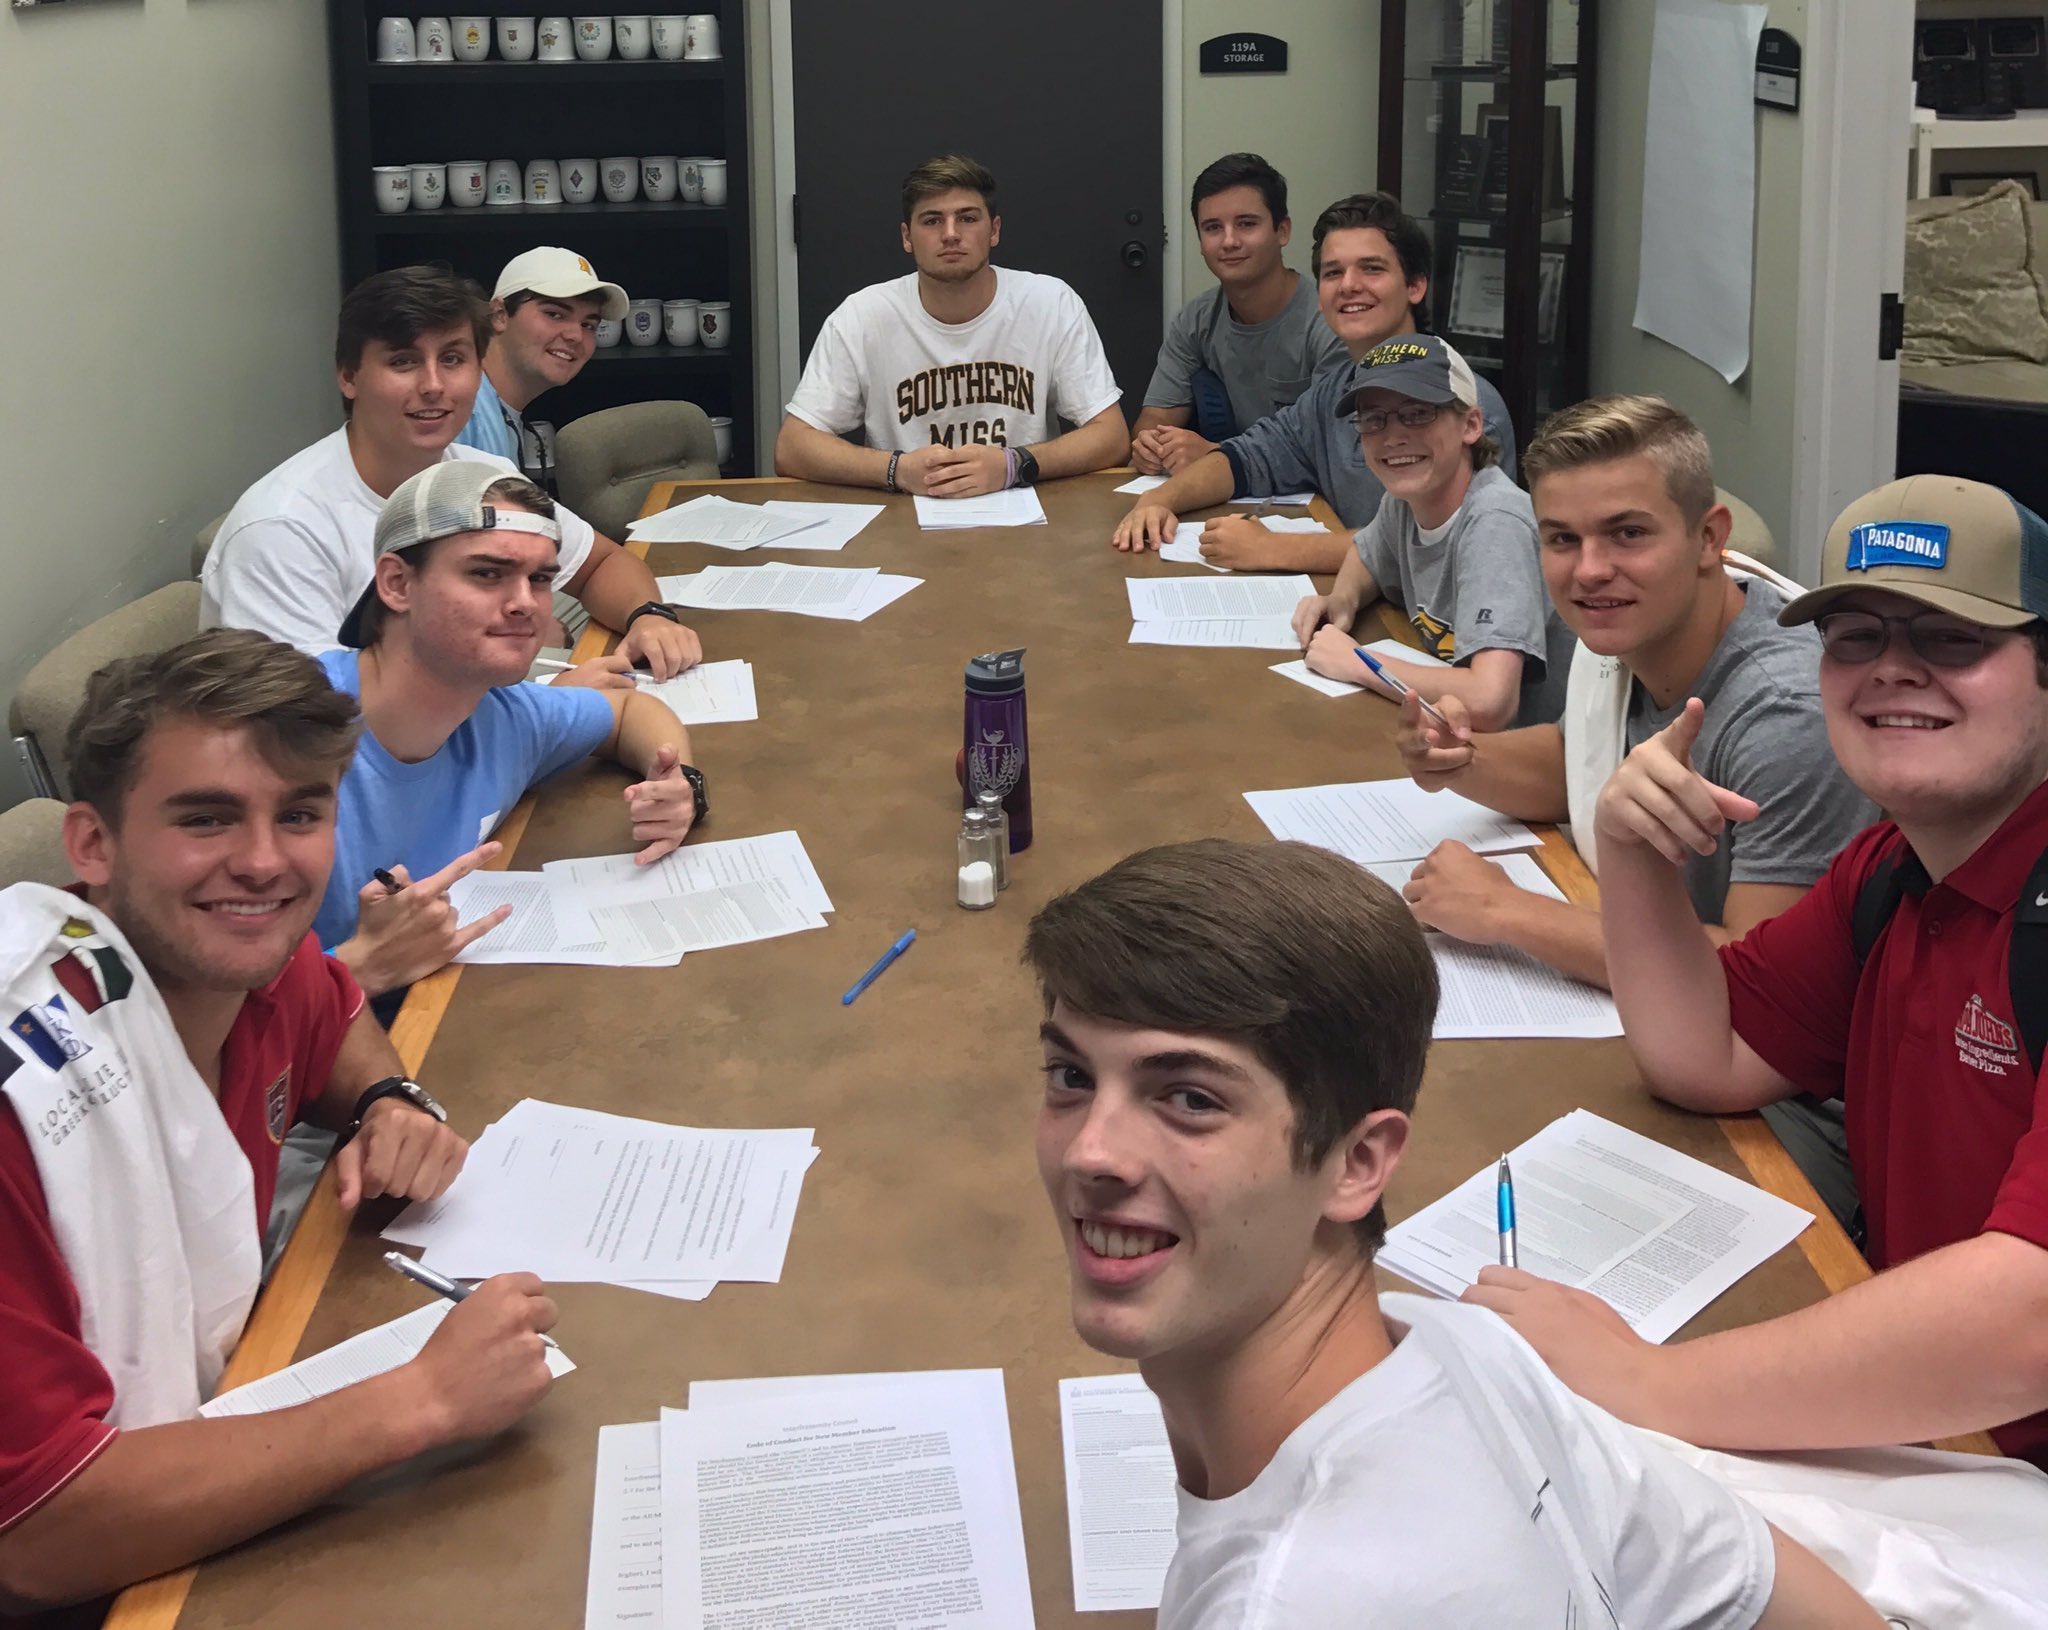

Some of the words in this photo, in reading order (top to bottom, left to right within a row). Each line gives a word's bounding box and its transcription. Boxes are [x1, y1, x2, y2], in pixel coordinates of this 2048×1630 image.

[1231, 43, 1257, 52] 119A
[1223, 54, 1265, 63] STORAGE
[1371, 354, 1401, 366] MISS
[896, 361, 1035, 425] SOUTHERN
[929, 418, 1007, 450] MISS
[1867, 528, 1940, 559] PATAGONIA
